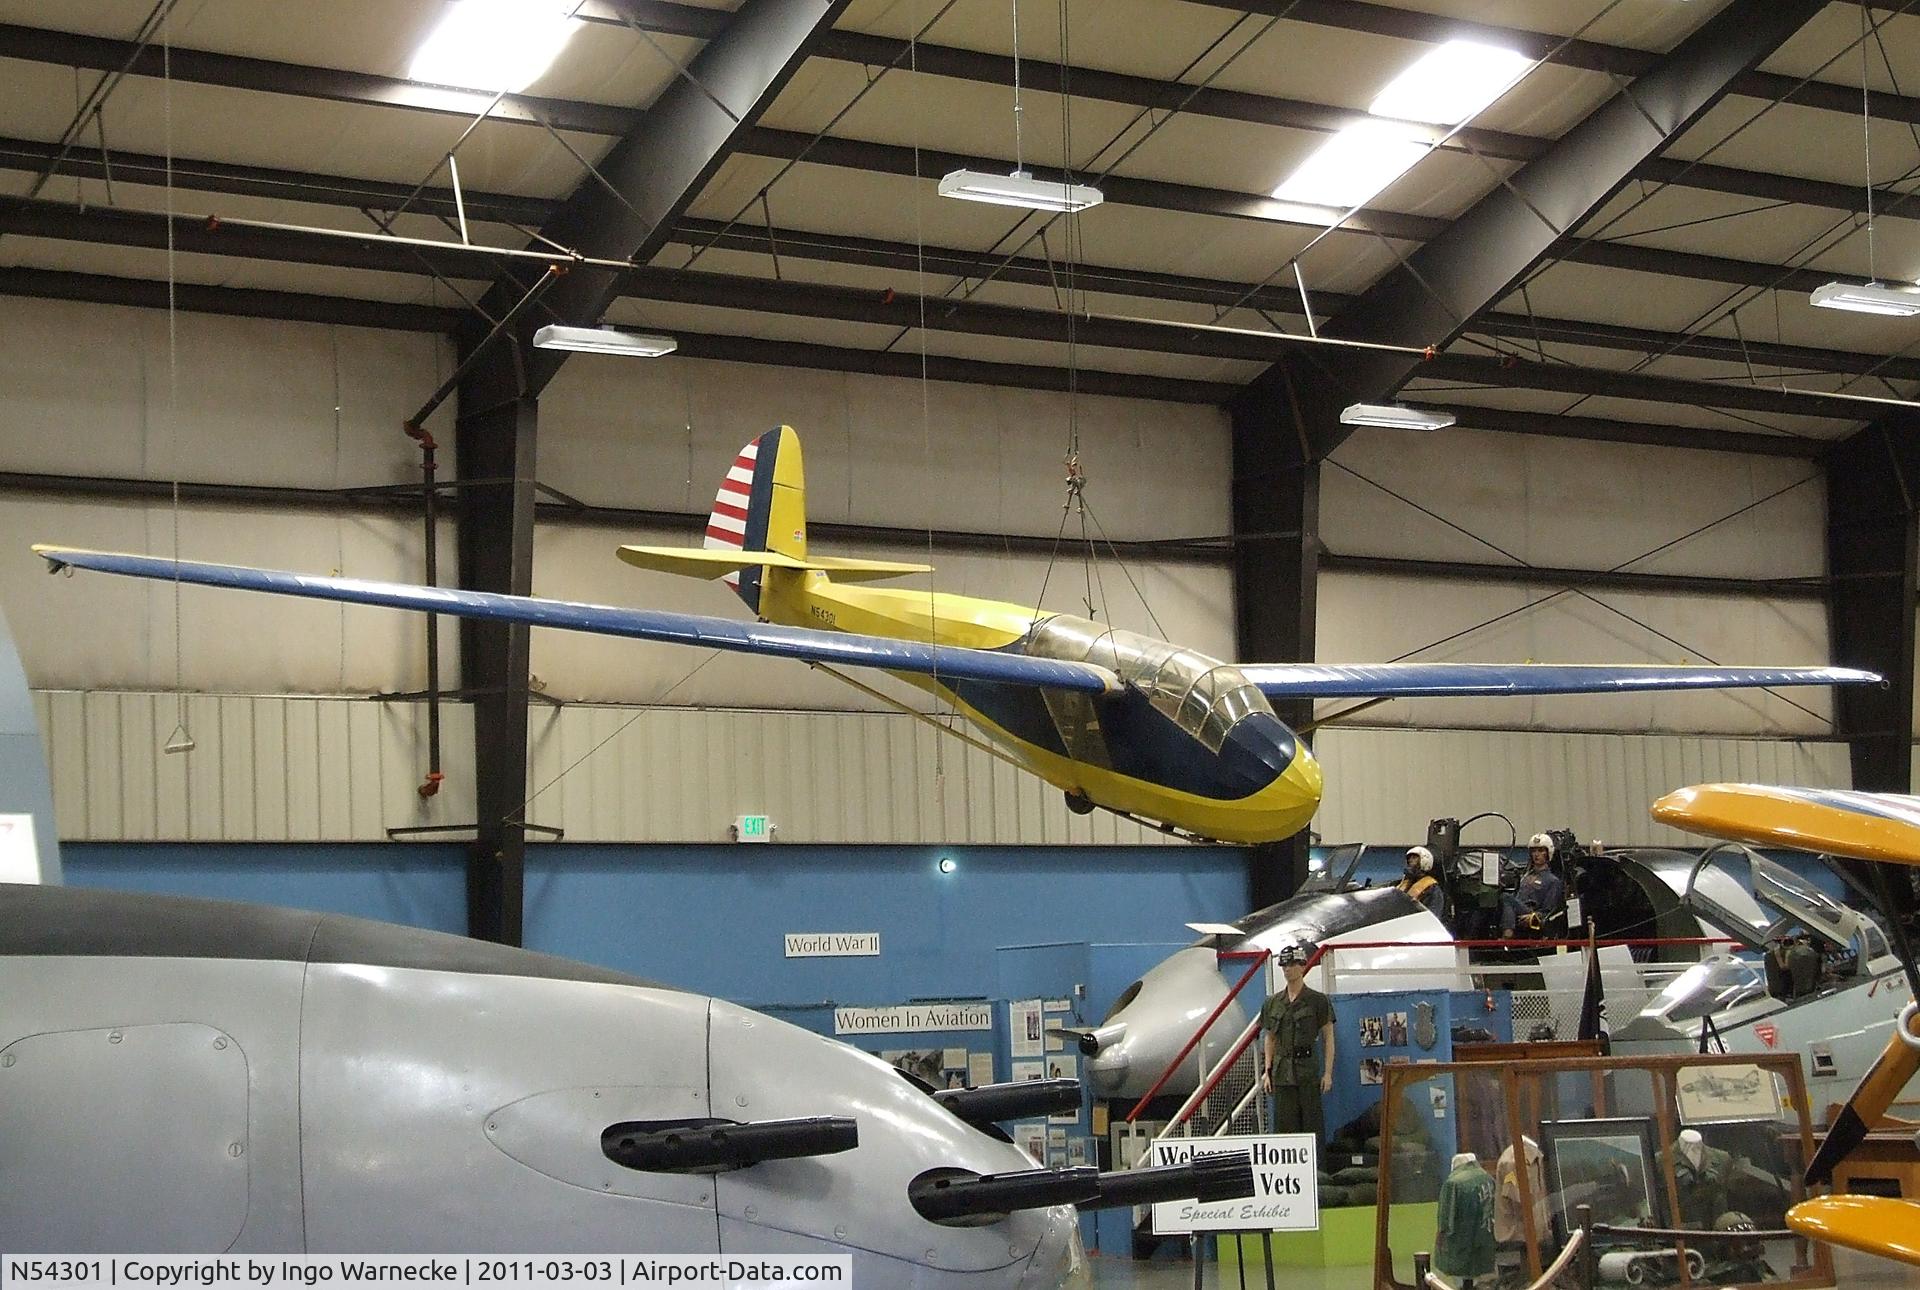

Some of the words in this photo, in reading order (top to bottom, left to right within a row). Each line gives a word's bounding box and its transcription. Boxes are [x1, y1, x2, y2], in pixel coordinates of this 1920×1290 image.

[745, 817, 765, 835] EXIT
[787, 936, 831, 952] World
[836, 936, 865, 951] War
[870, 936, 877, 951] II
[837, 1012, 900, 1030] Women
[906, 1010, 920, 1028] In
[925, 1009, 989, 1027] Aviation
[1253, 1143, 1308, 1165] Home
[1260, 1172, 1301, 1195] Vets
[1180, 1207, 1234, 1222] Special
[1240, 1204, 1291, 1219] Exhibit
